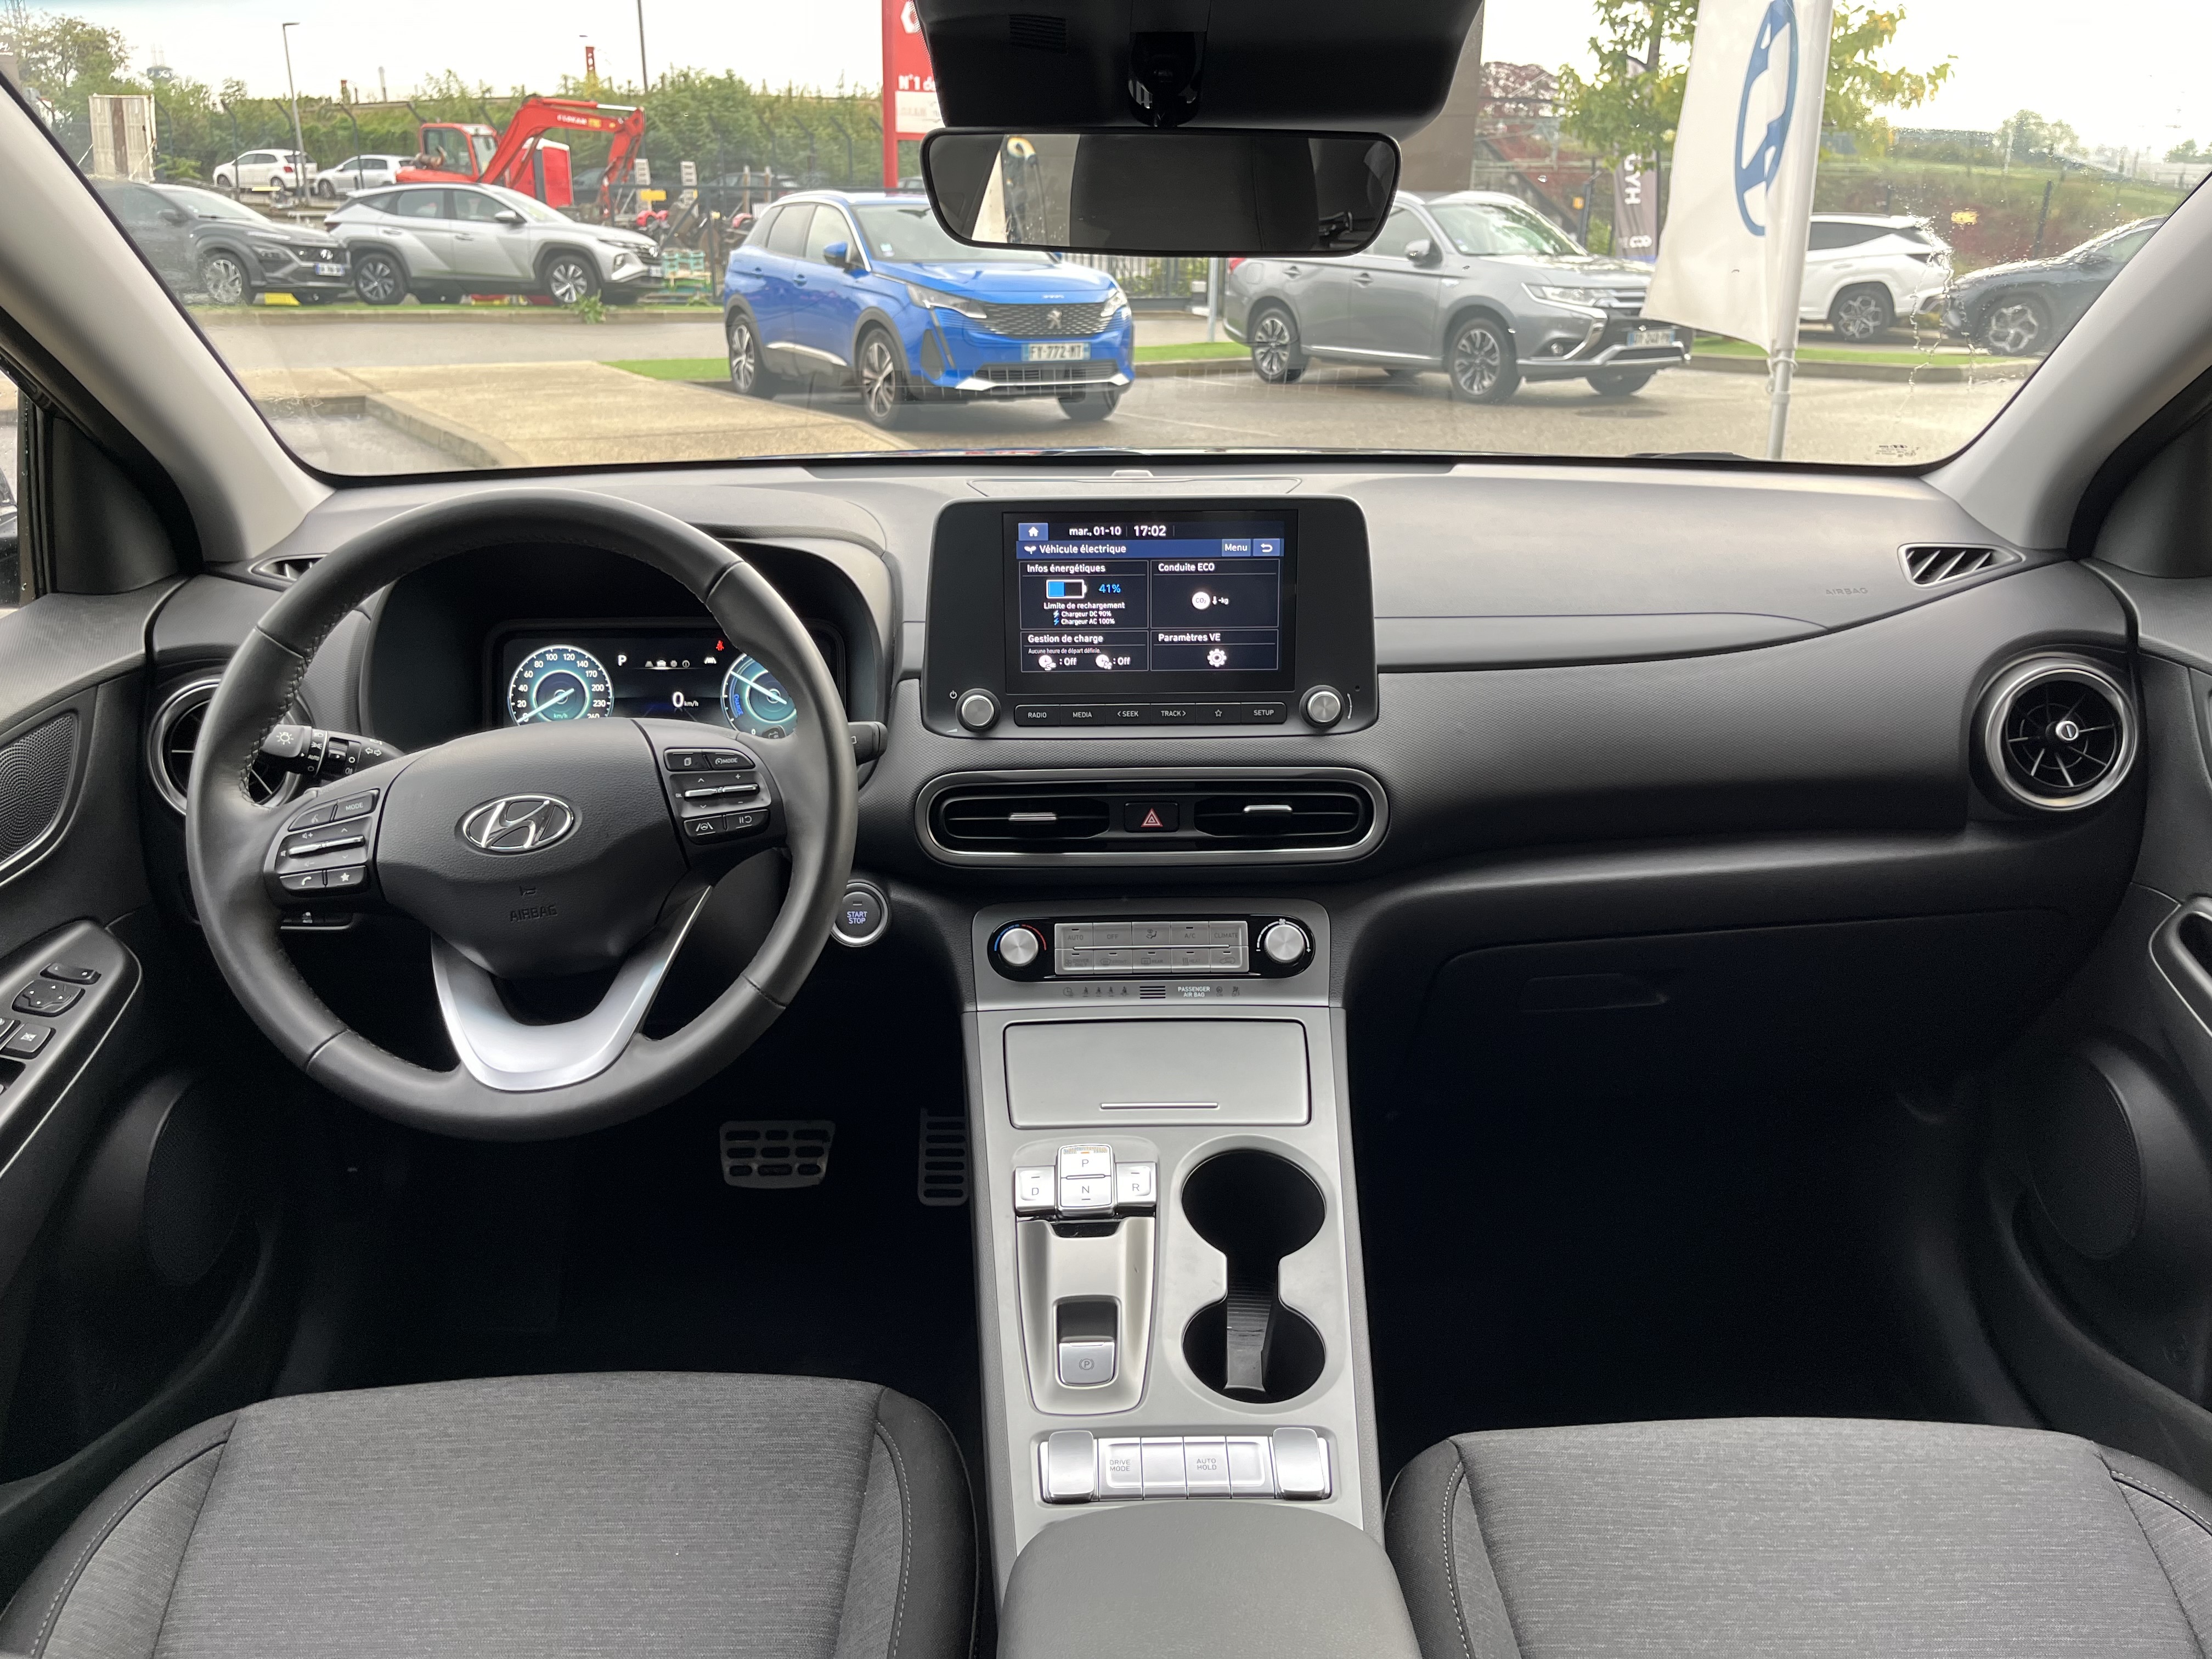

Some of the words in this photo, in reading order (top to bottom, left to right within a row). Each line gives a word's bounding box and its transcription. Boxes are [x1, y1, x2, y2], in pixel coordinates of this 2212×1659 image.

[1093, 526, 1122, 536] 01-10
[1133, 525, 1166, 537] 17:02
[1039, 545, 1078, 554] Véhicule
[1080, 544, 1126, 555] électrique
[1224, 543, 1248, 551] Menu
[1027, 564, 1048, 573] Infos
[1049, 563, 1106, 574] énergétiques
[1158, 563, 1196, 572] Conduite
[1198, 563, 1215, 571] ECO
[1098, 584, 1121, 593] 41%
[1077, 602, 1125, 611] rechargement
[1028, 635, 1059, 644] Gestion
[1062, 634, 1073, 643] de
[1074, 634, 1104, 644] charge
[1158, 633, 1208, 642] Paramètres
[1209, 633, 1221, 641] VE
[617, 654, 627, 666] P
[672, 691, 684, 708] 0
[345, 802, 364, 811] MODE
[510, 906, 558, 923] AIRBAG
[1081, 1159, 1090, 1168] P
[1031, 1187, 1040, 1196] D
[1081, 1186, 1090, 1194] N
[1132, 1183, 1140, 1192] R
